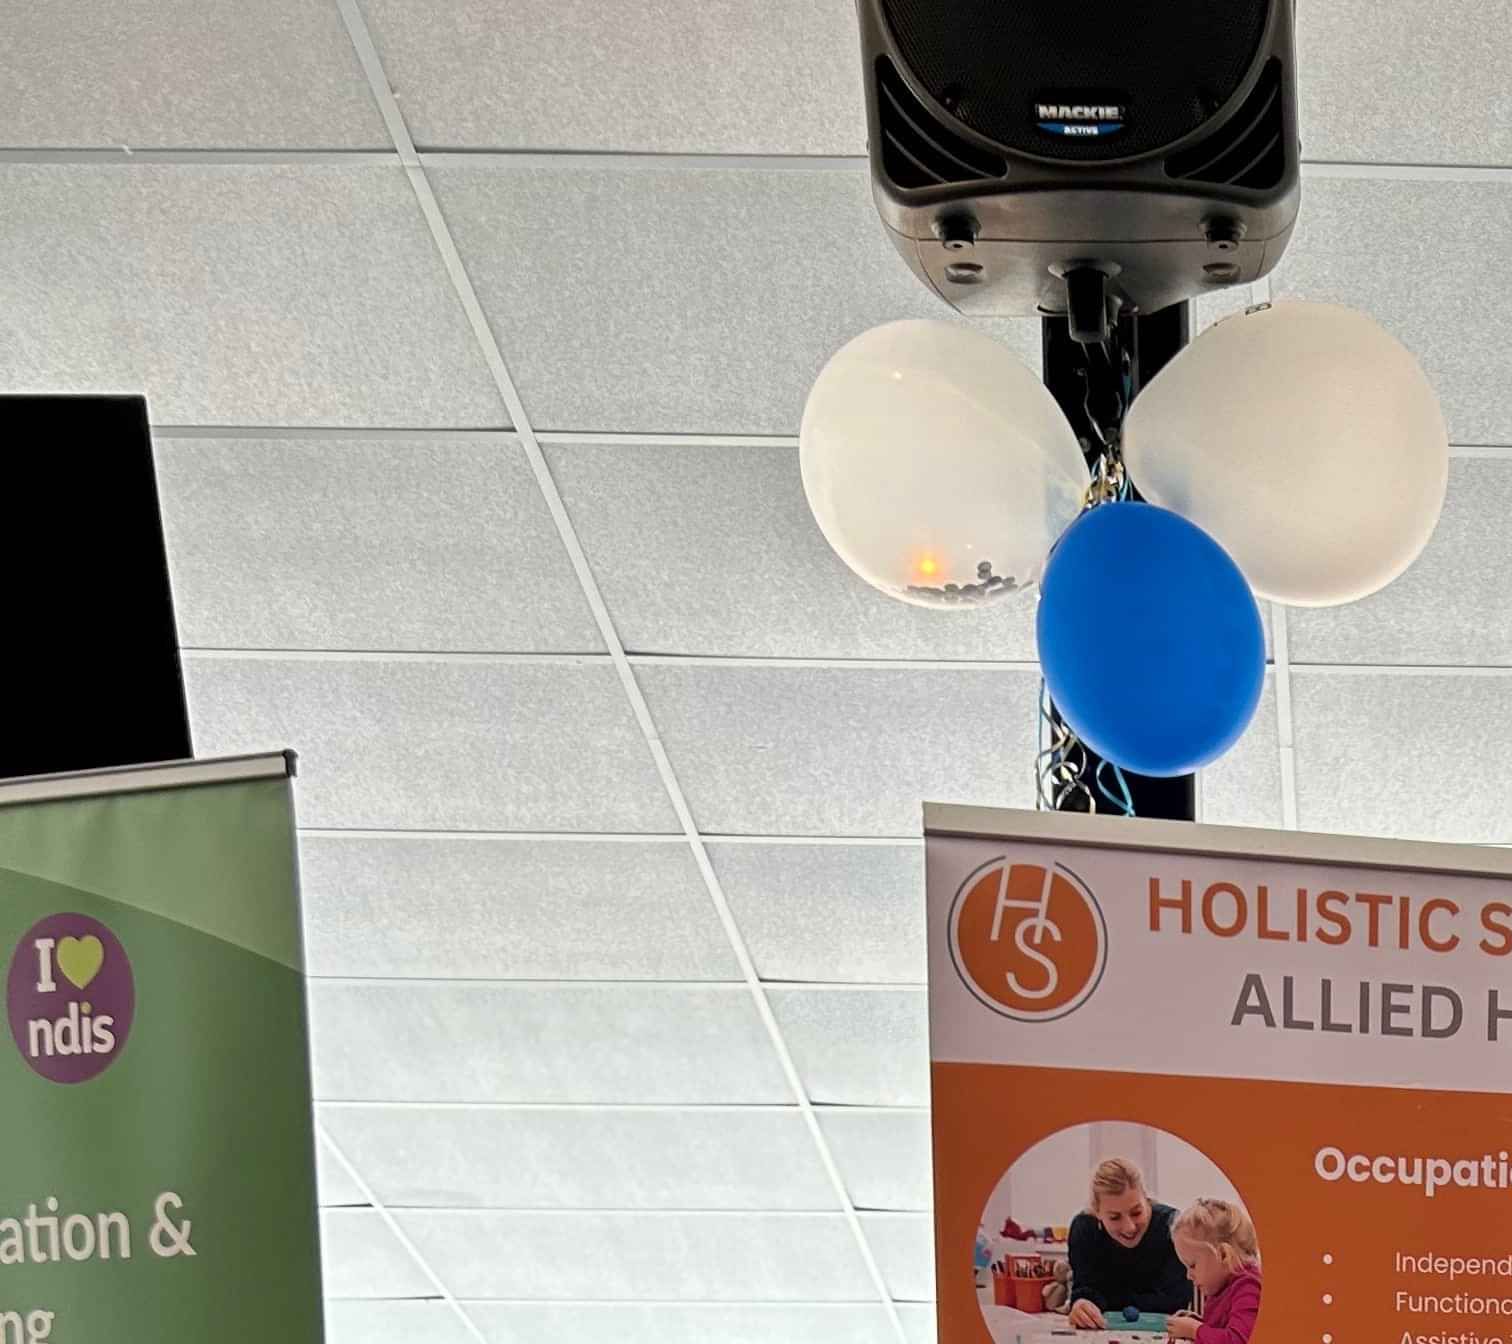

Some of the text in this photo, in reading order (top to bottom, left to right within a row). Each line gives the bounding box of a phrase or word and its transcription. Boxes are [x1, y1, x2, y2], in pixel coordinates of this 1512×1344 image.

[1039, 104, 1119, 119] MACKIE
[1149, 877, 1461, 953] HOLISTIC
[28, 1001, 116, 1057] ndis
[1230, 973, 1464, 1039] ALLIED
[149, 1191, 197, 1257] &
